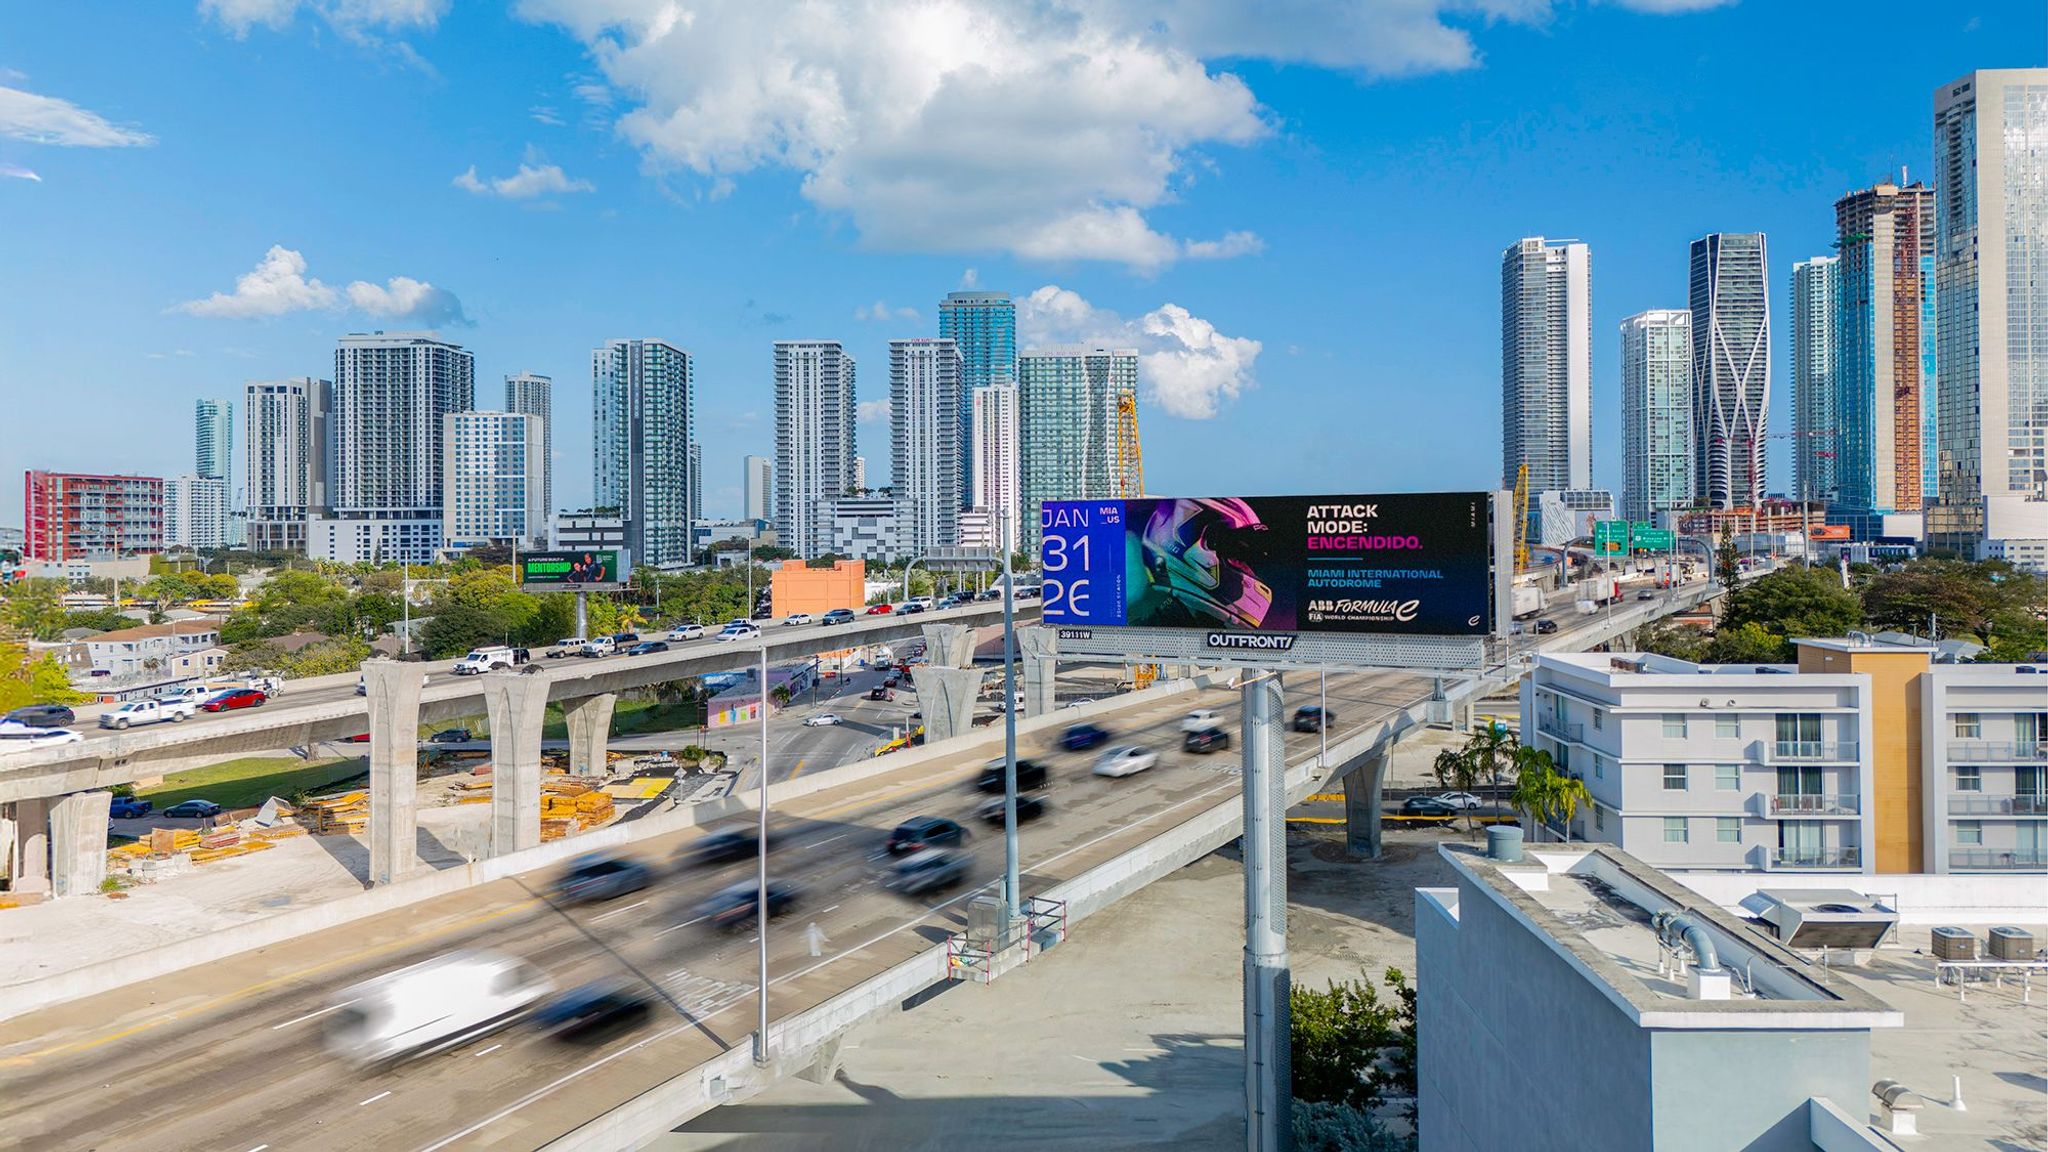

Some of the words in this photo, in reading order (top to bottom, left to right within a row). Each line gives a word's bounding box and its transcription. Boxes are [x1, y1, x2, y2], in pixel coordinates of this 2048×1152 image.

[1099, 507, 1118, 515] MIA
[1307, 504, 1379, 518] ATTACK
[1042, 509, 1089, 528] JAN
[1307, 520, 1369, 534] MODE:
[1307, 535, 1424, 550] ENCENDIDO.
[1042, 535, 1090, 572] 31
[527, 562, 572, 573] MENTORSHIP
[1307, 569, 1345, 578] MIAMI
[1347, 569, 1444, 579] INTERNATIONAL
[1307, 578, 1382, 588] AUTODROME
[1307, 600, 1334, 611] ABB
[1334, 599, 1398, 614] FORMULA
[1308, 613, 1323, 621] FIA
[1347, 614, 1395, 622] CHAMPIONSHIP
[1060, 630, 1090, 639] 39111W
